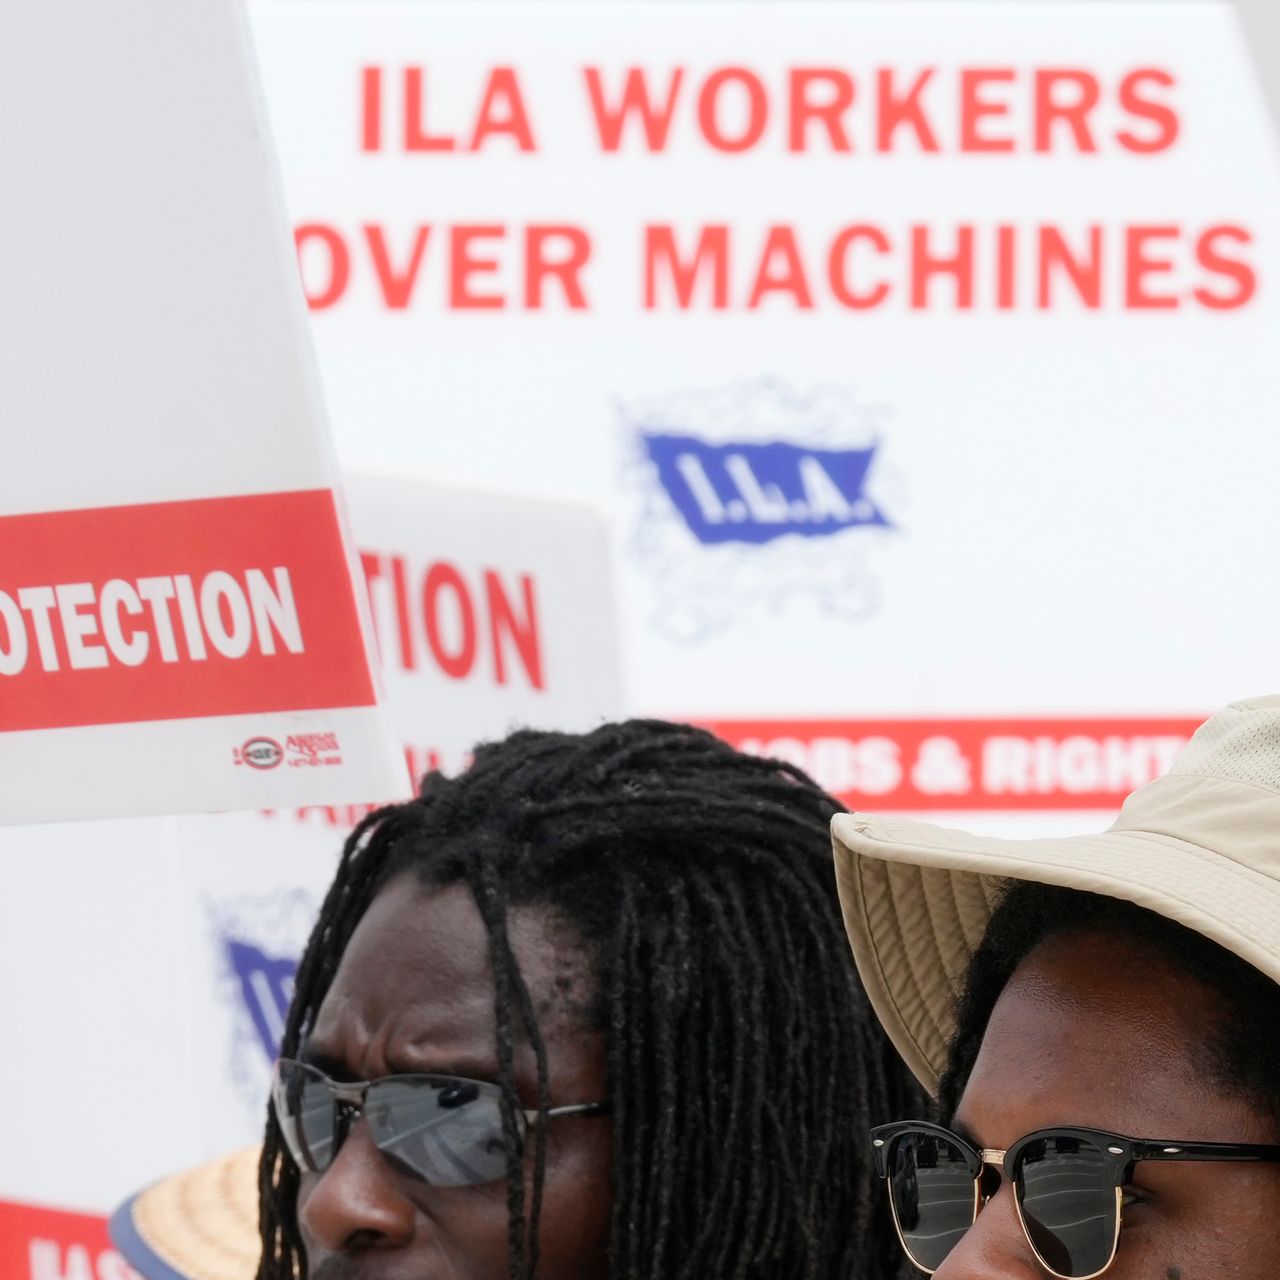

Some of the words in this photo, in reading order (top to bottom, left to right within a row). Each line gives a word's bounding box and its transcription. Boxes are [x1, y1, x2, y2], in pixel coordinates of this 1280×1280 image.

[361, 64, 538, 154] ILA
[582, 64, 1182, 156] WORKERS
[293, 222, 594, 312] OVER
[642, 222, 1258, 312] MACHINES
[910, 735, 971, 796] &
